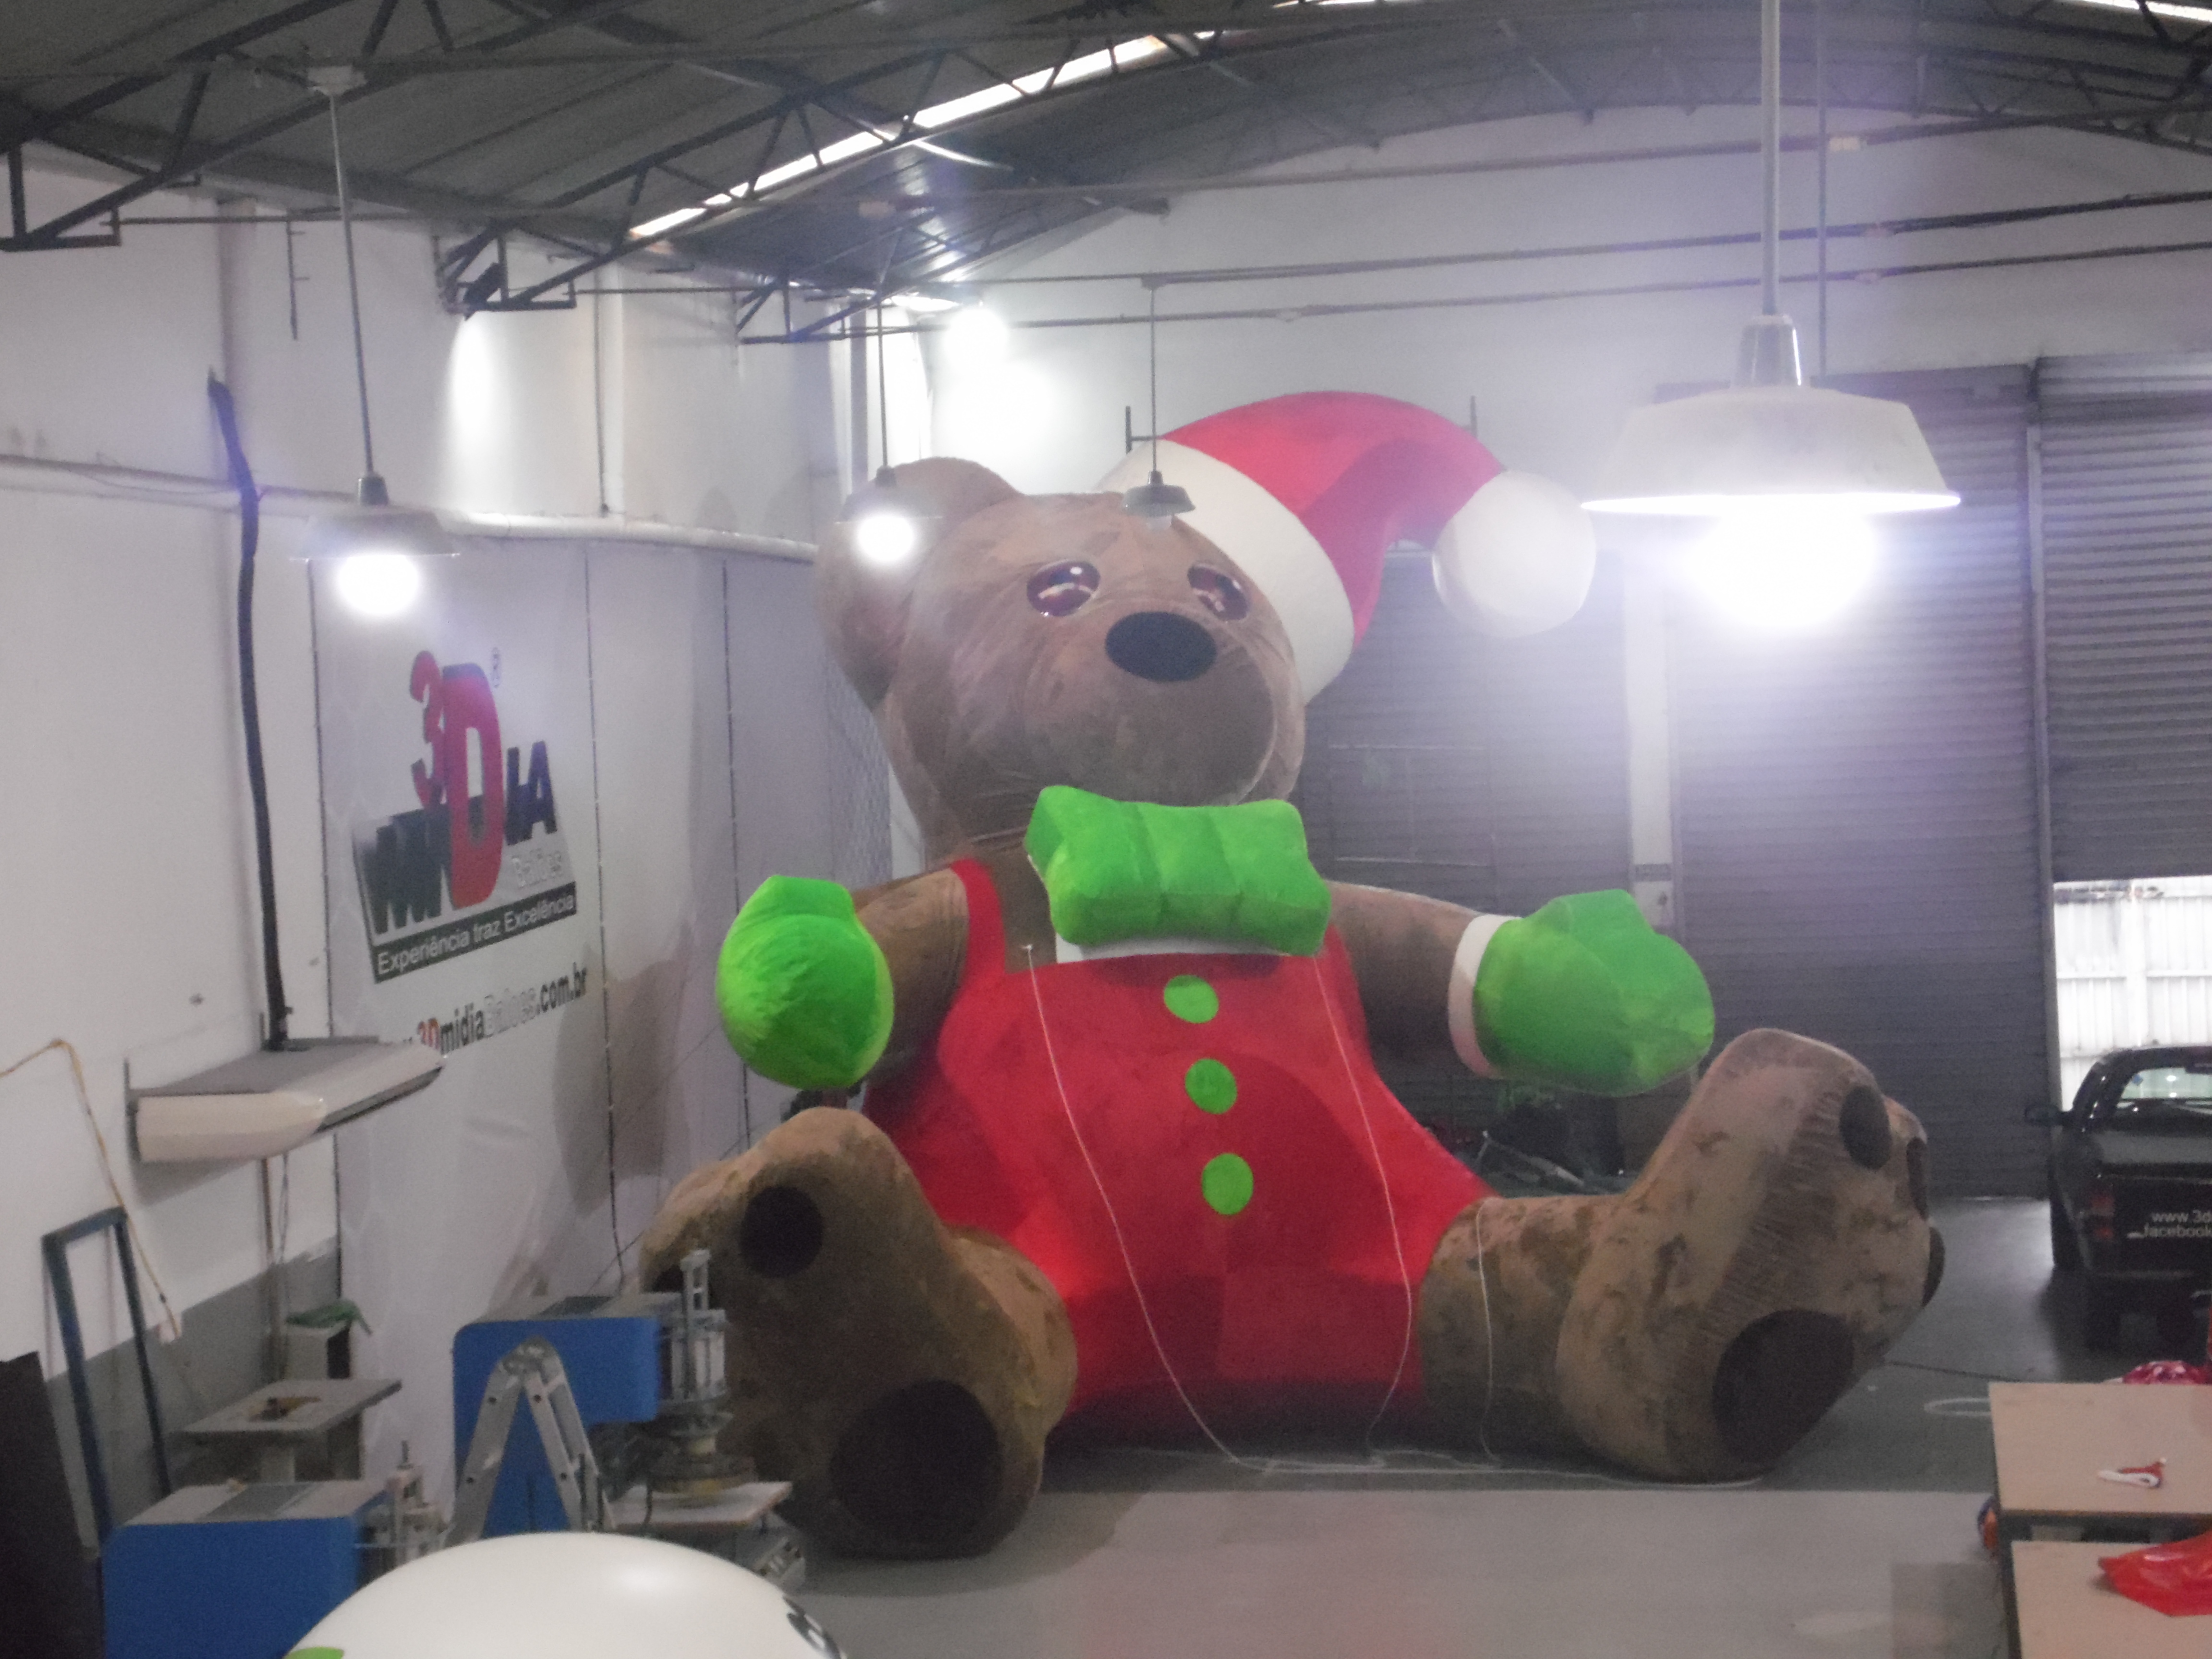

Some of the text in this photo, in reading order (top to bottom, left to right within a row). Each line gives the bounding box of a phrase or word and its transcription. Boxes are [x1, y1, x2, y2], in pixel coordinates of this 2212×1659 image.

[376, 894, 574, 974] Experiência traz Excelência
